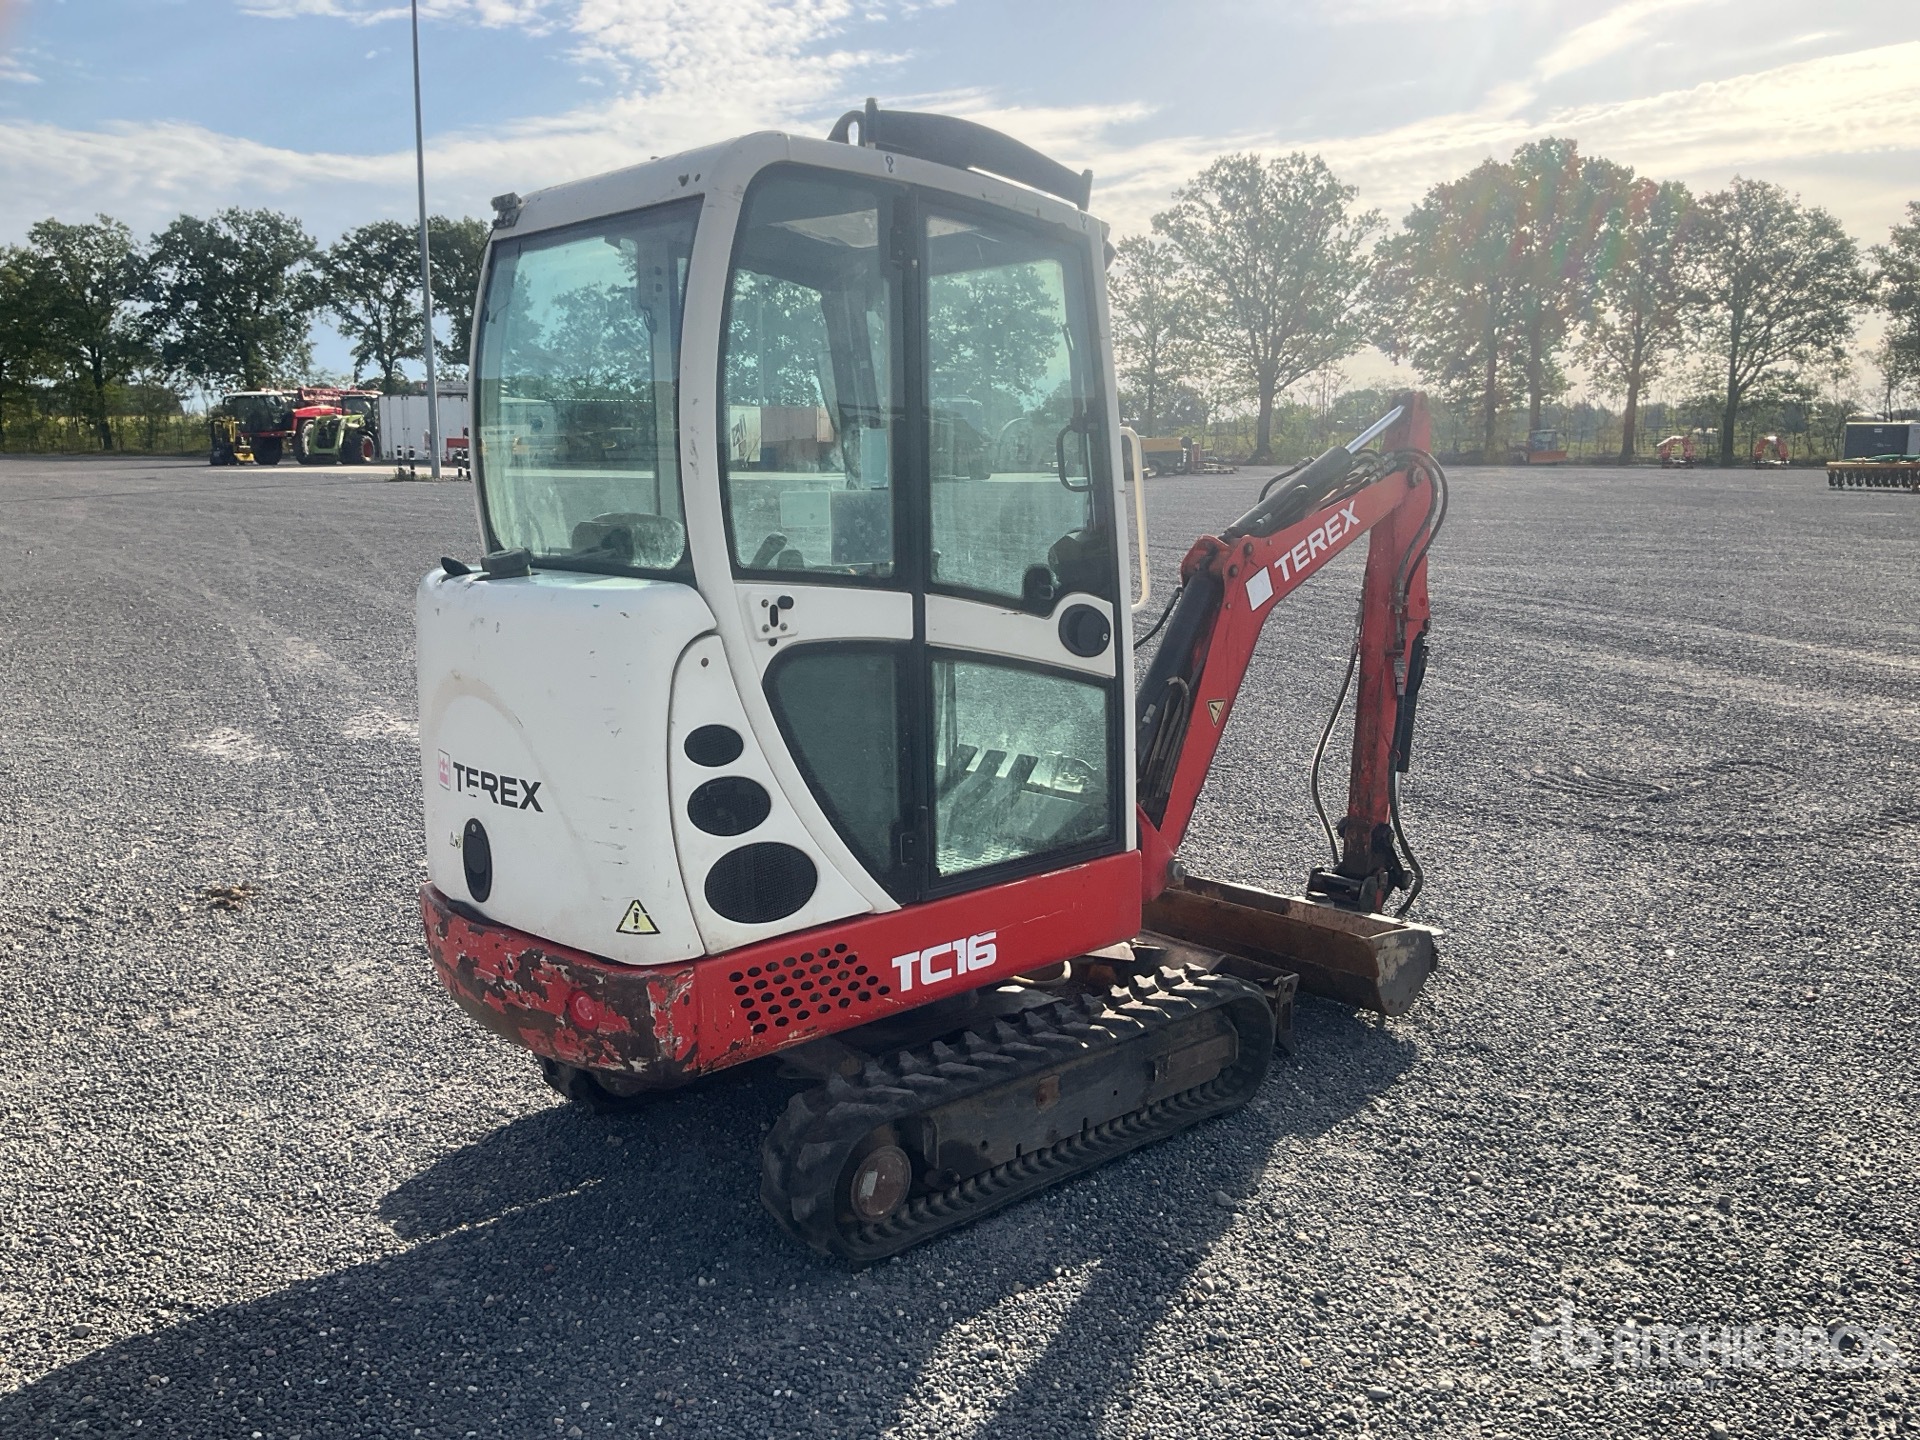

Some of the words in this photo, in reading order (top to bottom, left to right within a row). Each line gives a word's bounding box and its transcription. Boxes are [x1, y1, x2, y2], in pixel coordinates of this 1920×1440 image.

[1274, 500, 1360, 582] TEREX
[453, 762, 543, 812] TEREX
[892, 931, 997, 992] TC16
